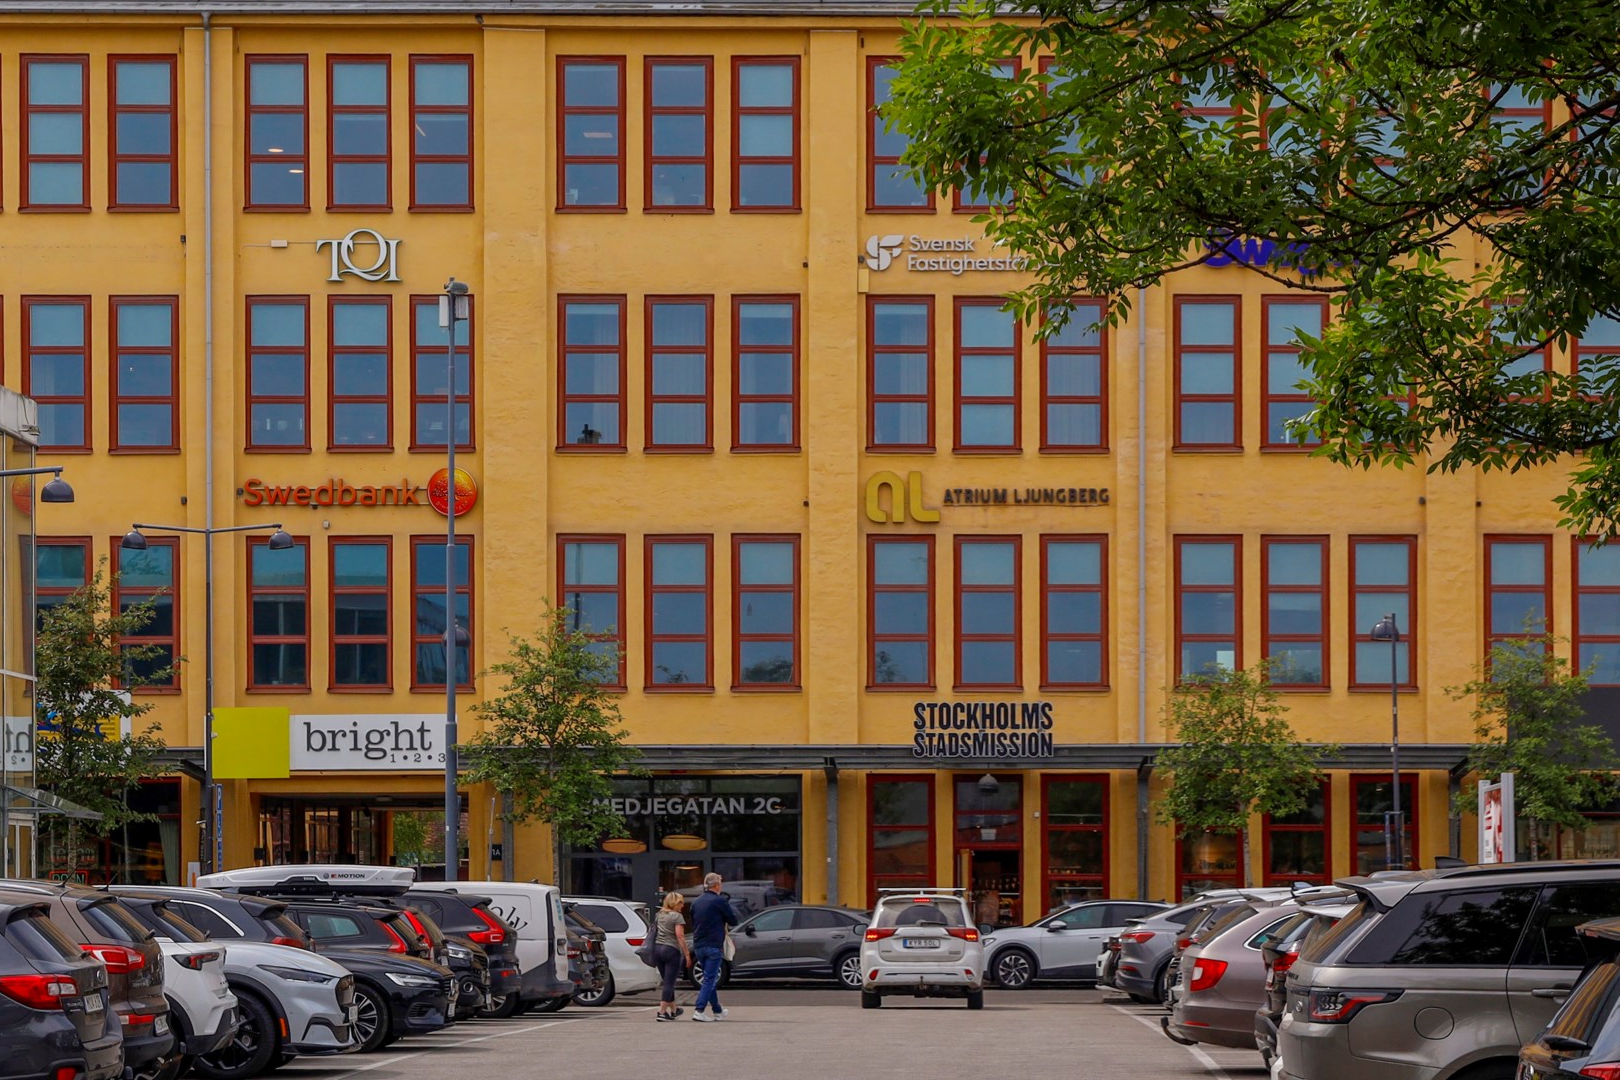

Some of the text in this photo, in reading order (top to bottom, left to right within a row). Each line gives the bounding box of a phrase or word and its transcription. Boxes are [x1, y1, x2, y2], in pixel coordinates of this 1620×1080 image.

[316, 228, 402, 282] TQI
[909, 235, 975, 252] Svensk
[244, 478, 419, 506] Swedbank
[943, 488, 1109, 504] ATRIUM LJUNGBERG
[913, 702, 1053, 730] STOCKHOLMS
[303, 721, 432, 760] bright
[913, 732, 1053, 757] STADSMISSION
[753, 797, 781, 815] 2C
